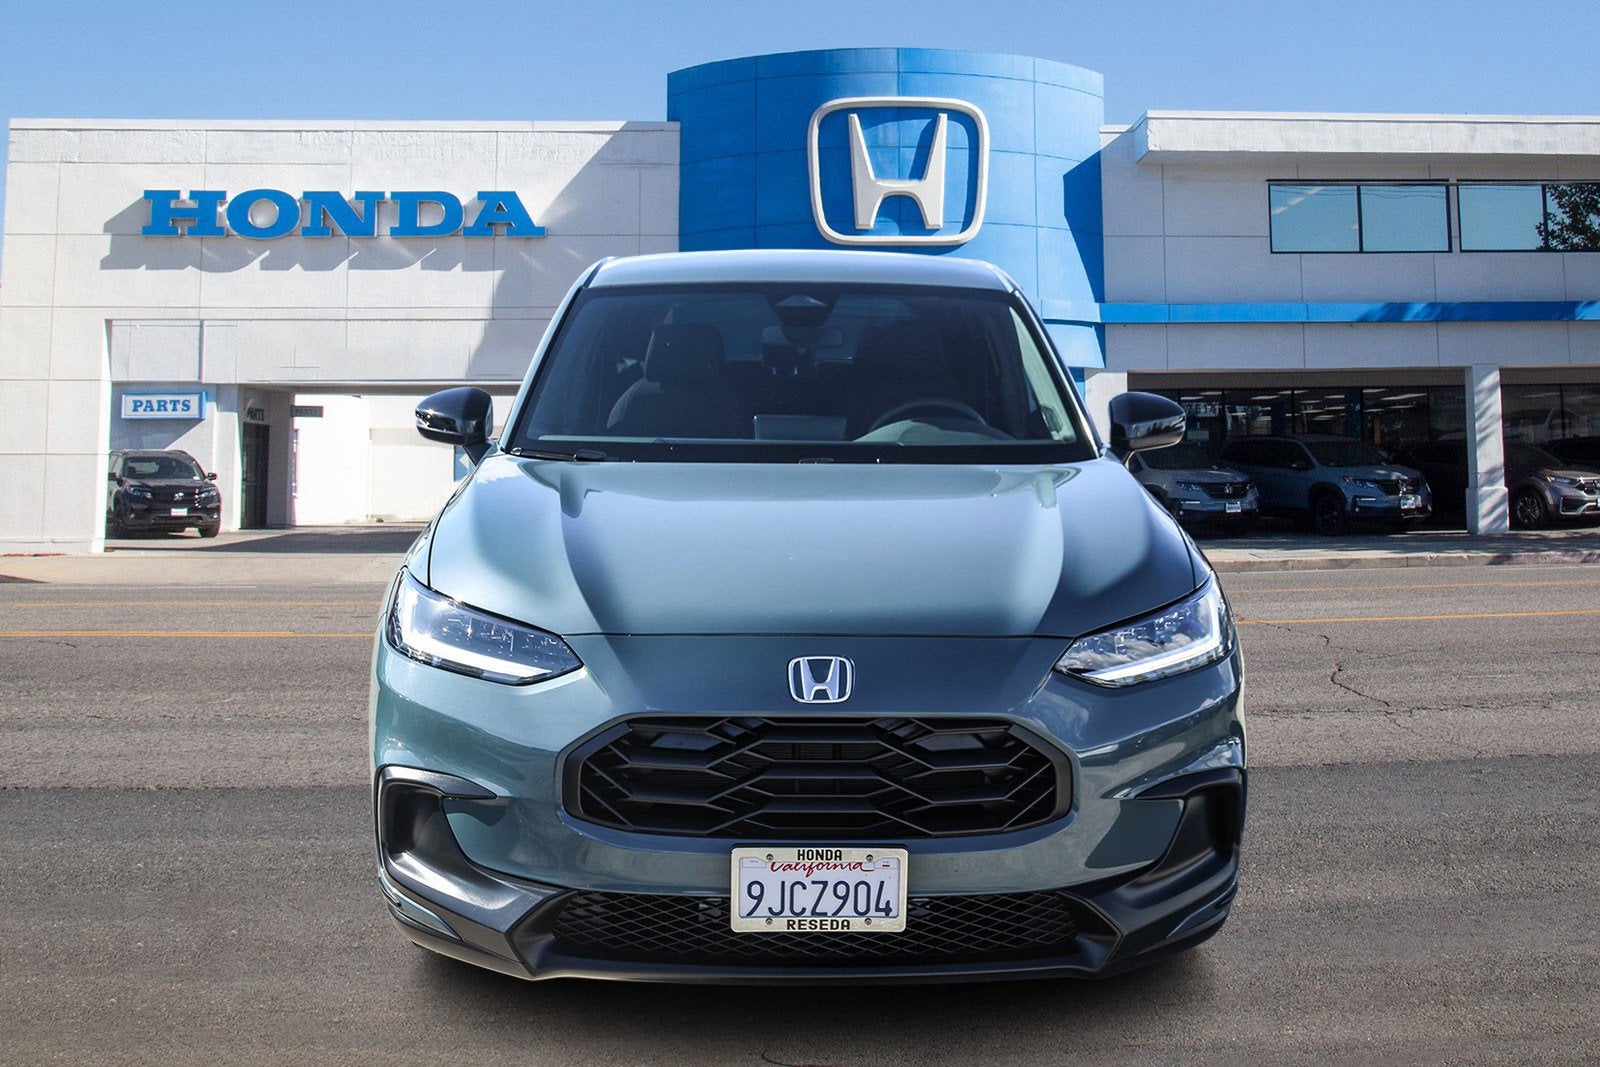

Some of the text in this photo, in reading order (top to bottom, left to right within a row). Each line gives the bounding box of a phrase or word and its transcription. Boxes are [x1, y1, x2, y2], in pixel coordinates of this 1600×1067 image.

[141, 188, 547, 239] HONDA
[131, 400, 191, 412] PARTS
[797, 849, 842, 861] HONDA
[746, 880, 893, 917] 9JCZ904
[786, 919, 850, 930] RESEDA
